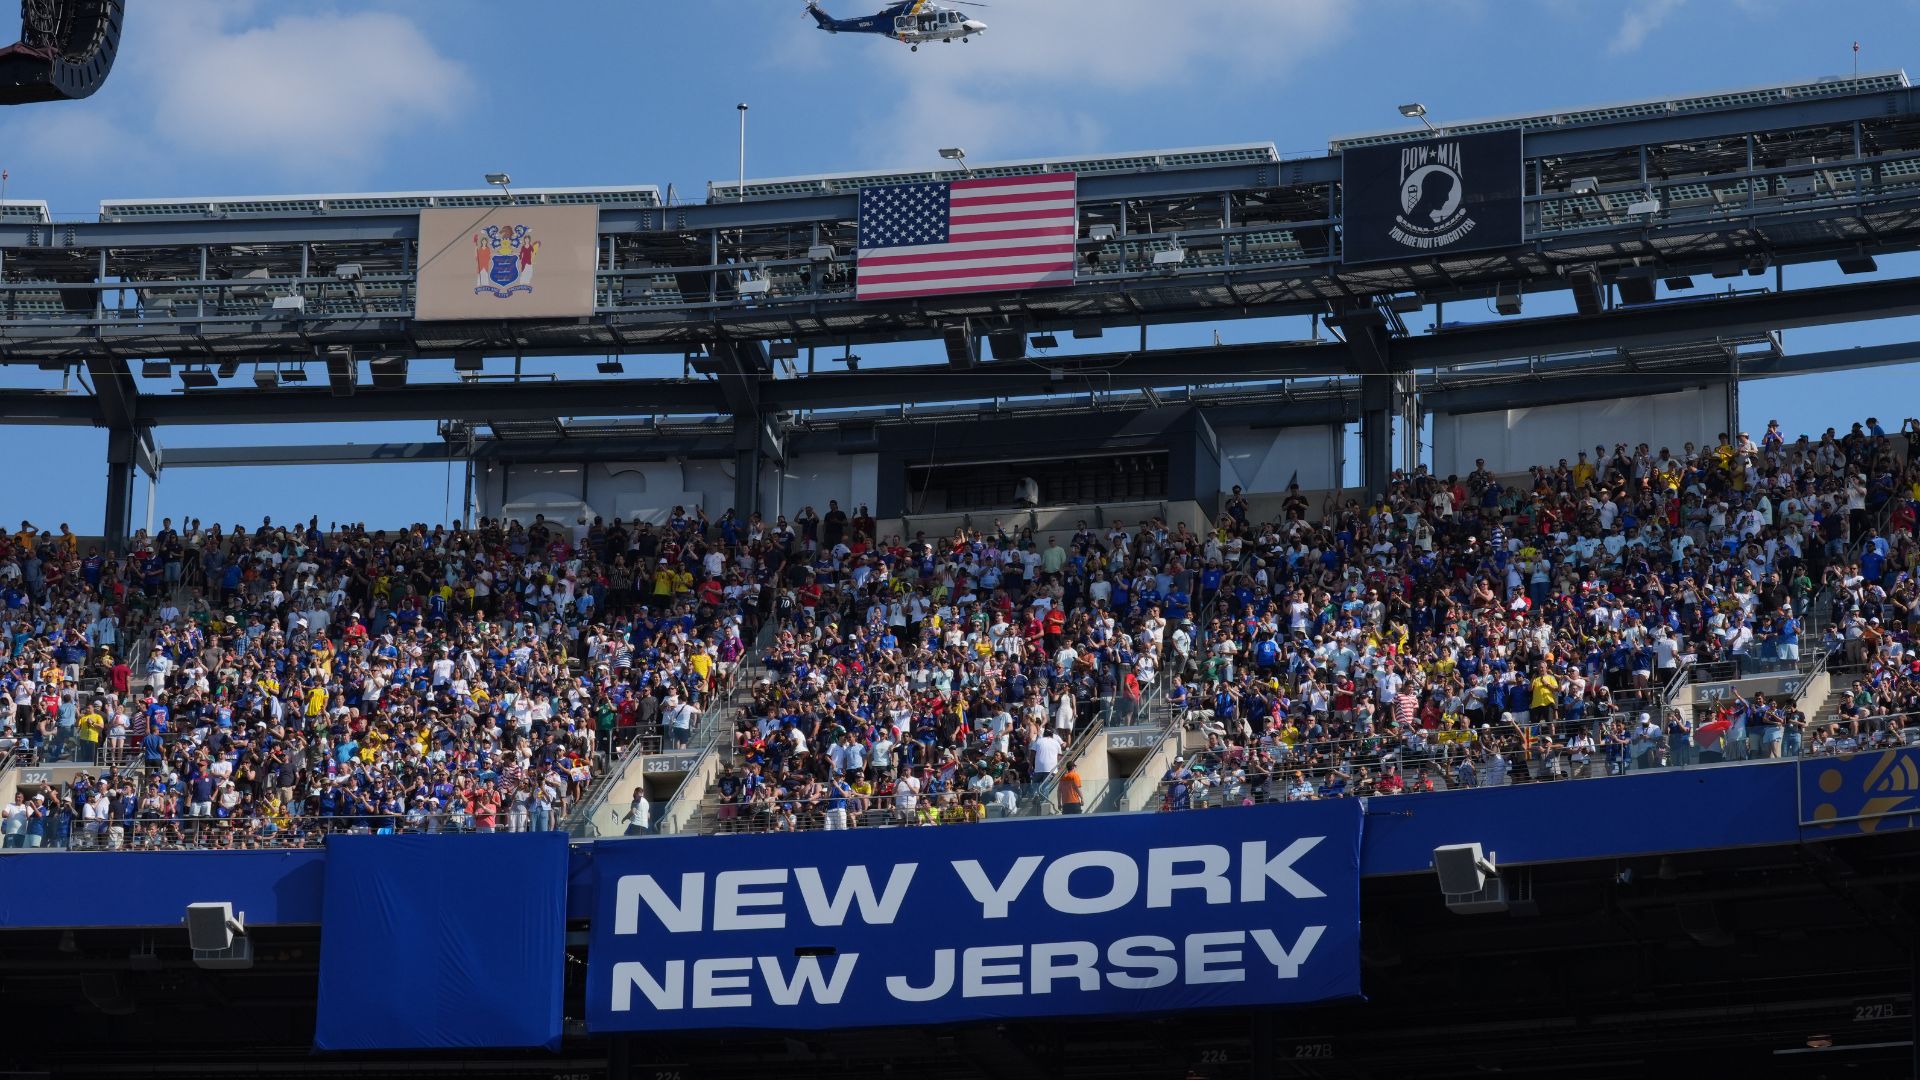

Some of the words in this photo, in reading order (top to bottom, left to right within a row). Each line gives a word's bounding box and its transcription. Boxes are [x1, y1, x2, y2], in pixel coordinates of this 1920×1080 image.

[1400, 146, 1429, 186] POW
[1437, 142, 1463, 180] MIA
[1388, 226, 1402, 242] YOU
[1401, 235, 1415, 247] ARE
[1417, 237, 1433, 248] NOT
[1434, 217, 1476, 247] FORGOTTEN
[1112, 736, 1134, 747] 326
[648, 760, 670, 772] 325
[615, 863, 918, 934] NEW
[951, 837, 1325, 918] YORK
[612, 953, 858, 1011] NEW
[886, 926, 1326, 1001] JERSEY
[1856, 1003, 1894, 1018] 227B
[1200, 1049, 1228, 1063] 226
[1296, 1043, 1333, 1058] 227B
